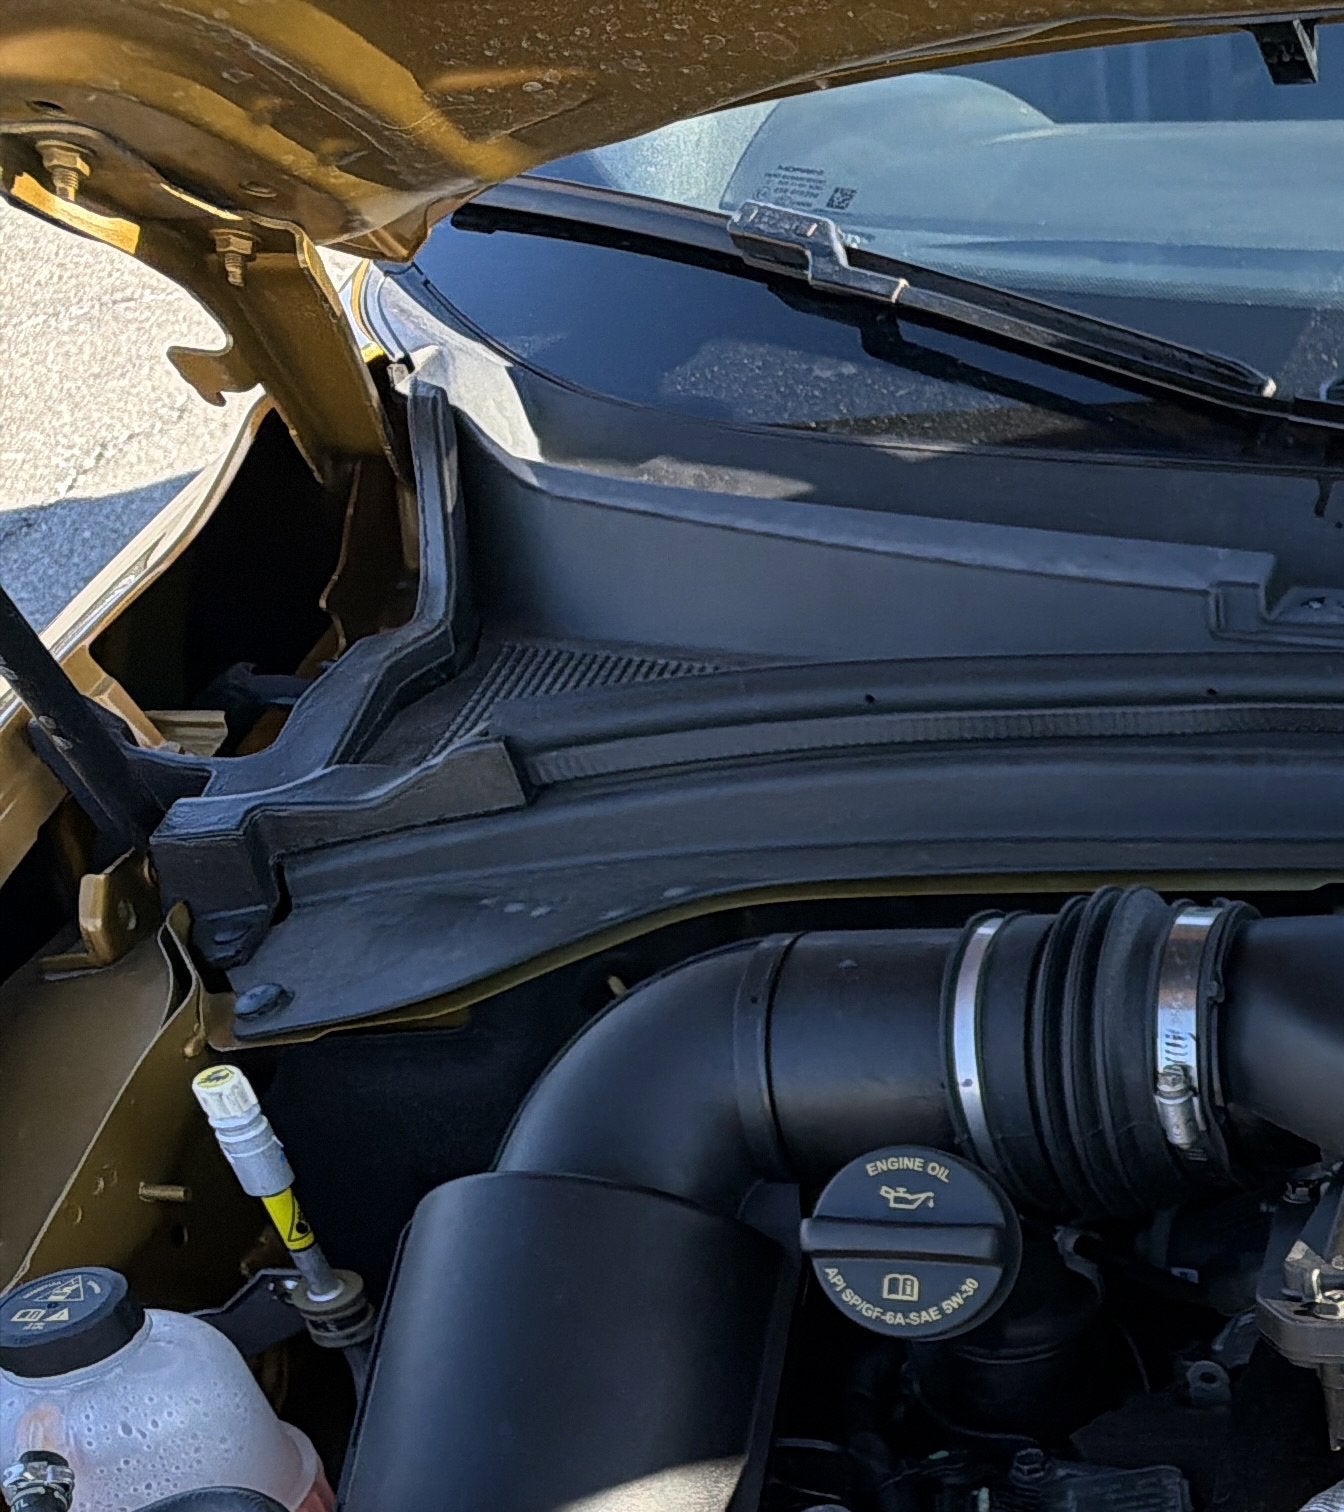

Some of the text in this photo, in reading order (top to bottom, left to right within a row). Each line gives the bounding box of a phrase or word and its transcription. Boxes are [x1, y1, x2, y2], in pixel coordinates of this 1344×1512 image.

[865, 1156, 952, 1184] ENGINE OIL
[824, 1266, 847, 1293] API
[943, 1277, 979, 1315] 5W-30
